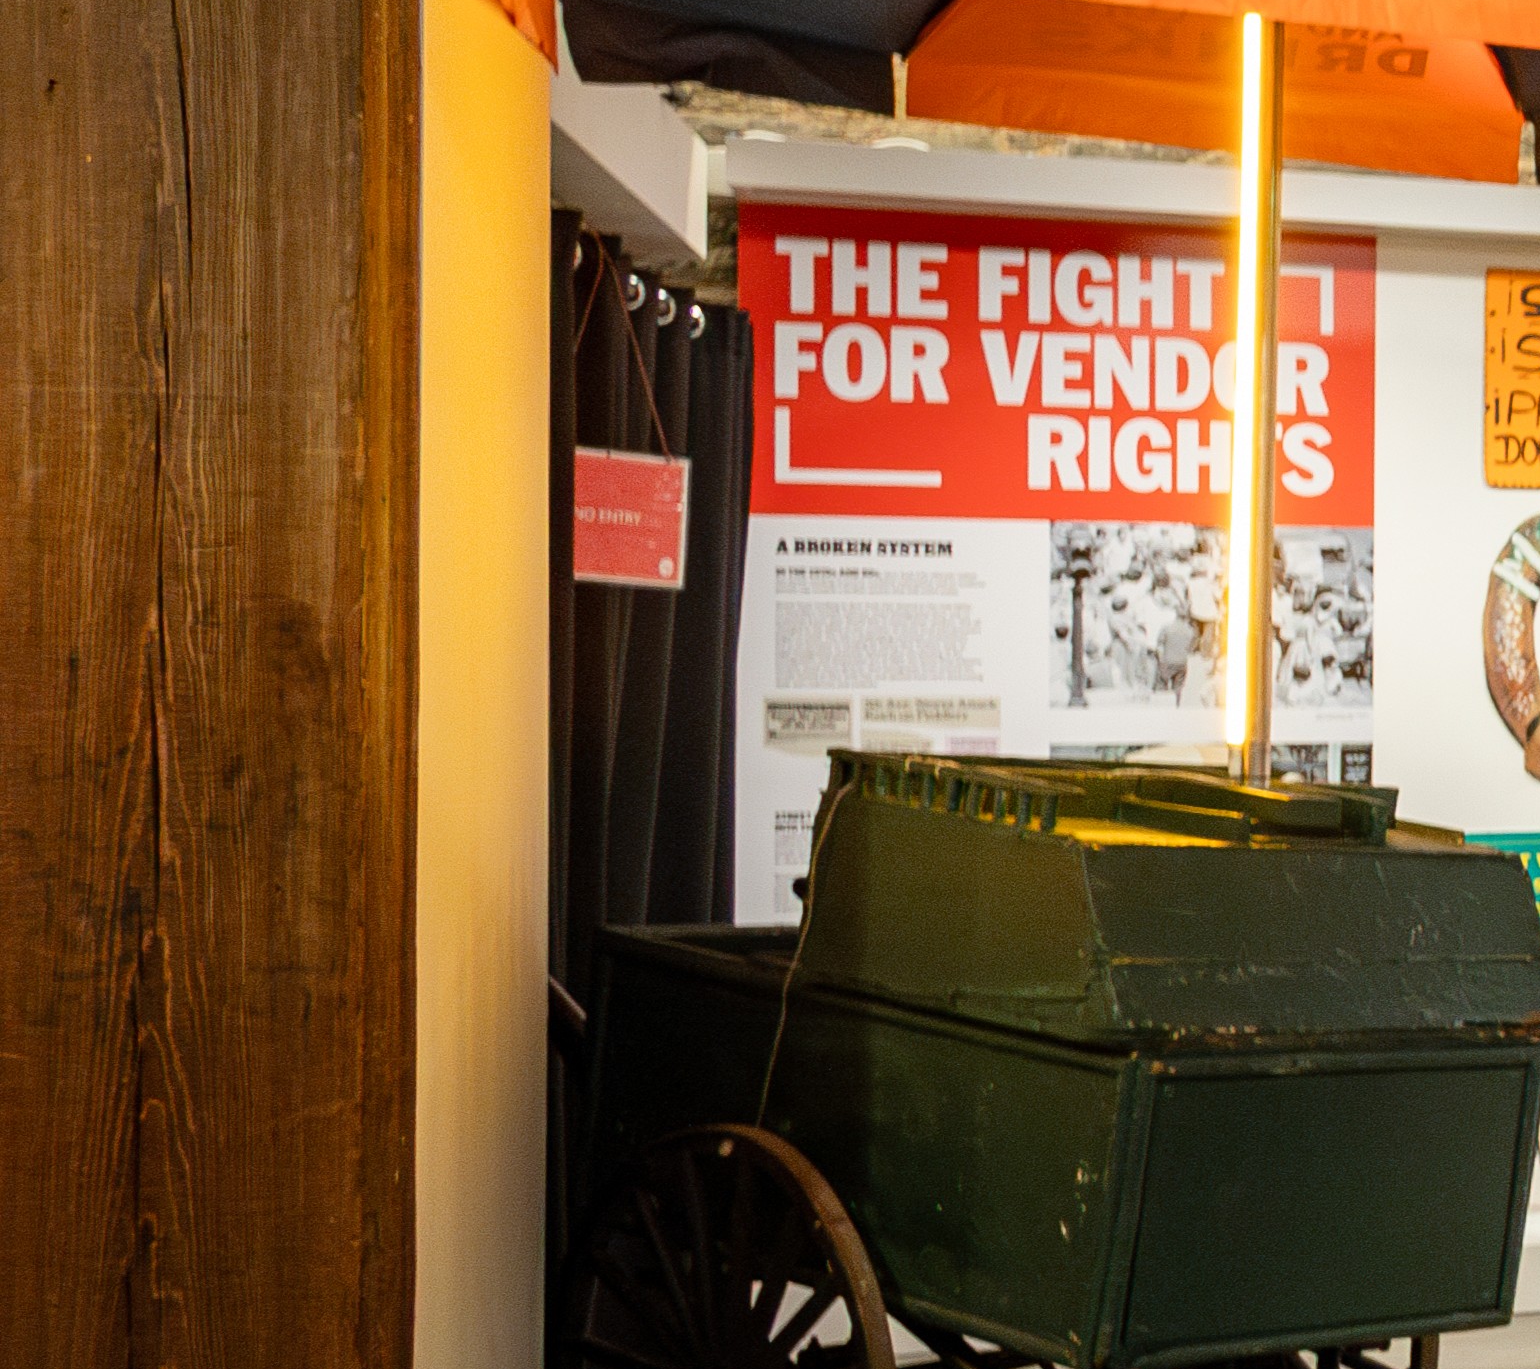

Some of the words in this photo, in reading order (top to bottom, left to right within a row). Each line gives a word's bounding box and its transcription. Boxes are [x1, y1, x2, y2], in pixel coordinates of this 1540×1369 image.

[774, 236, 949, 321] THE
[978, 246, 1225, 330] FIGHT
[774, 320, 950, 404] FOR
[1027, 413, 1335, 498] RIGHS
[776, 538, 788, 553] A
[794, 538, 872, 555] BROKEN
[876, 539, 953, 557] SYSTEM
